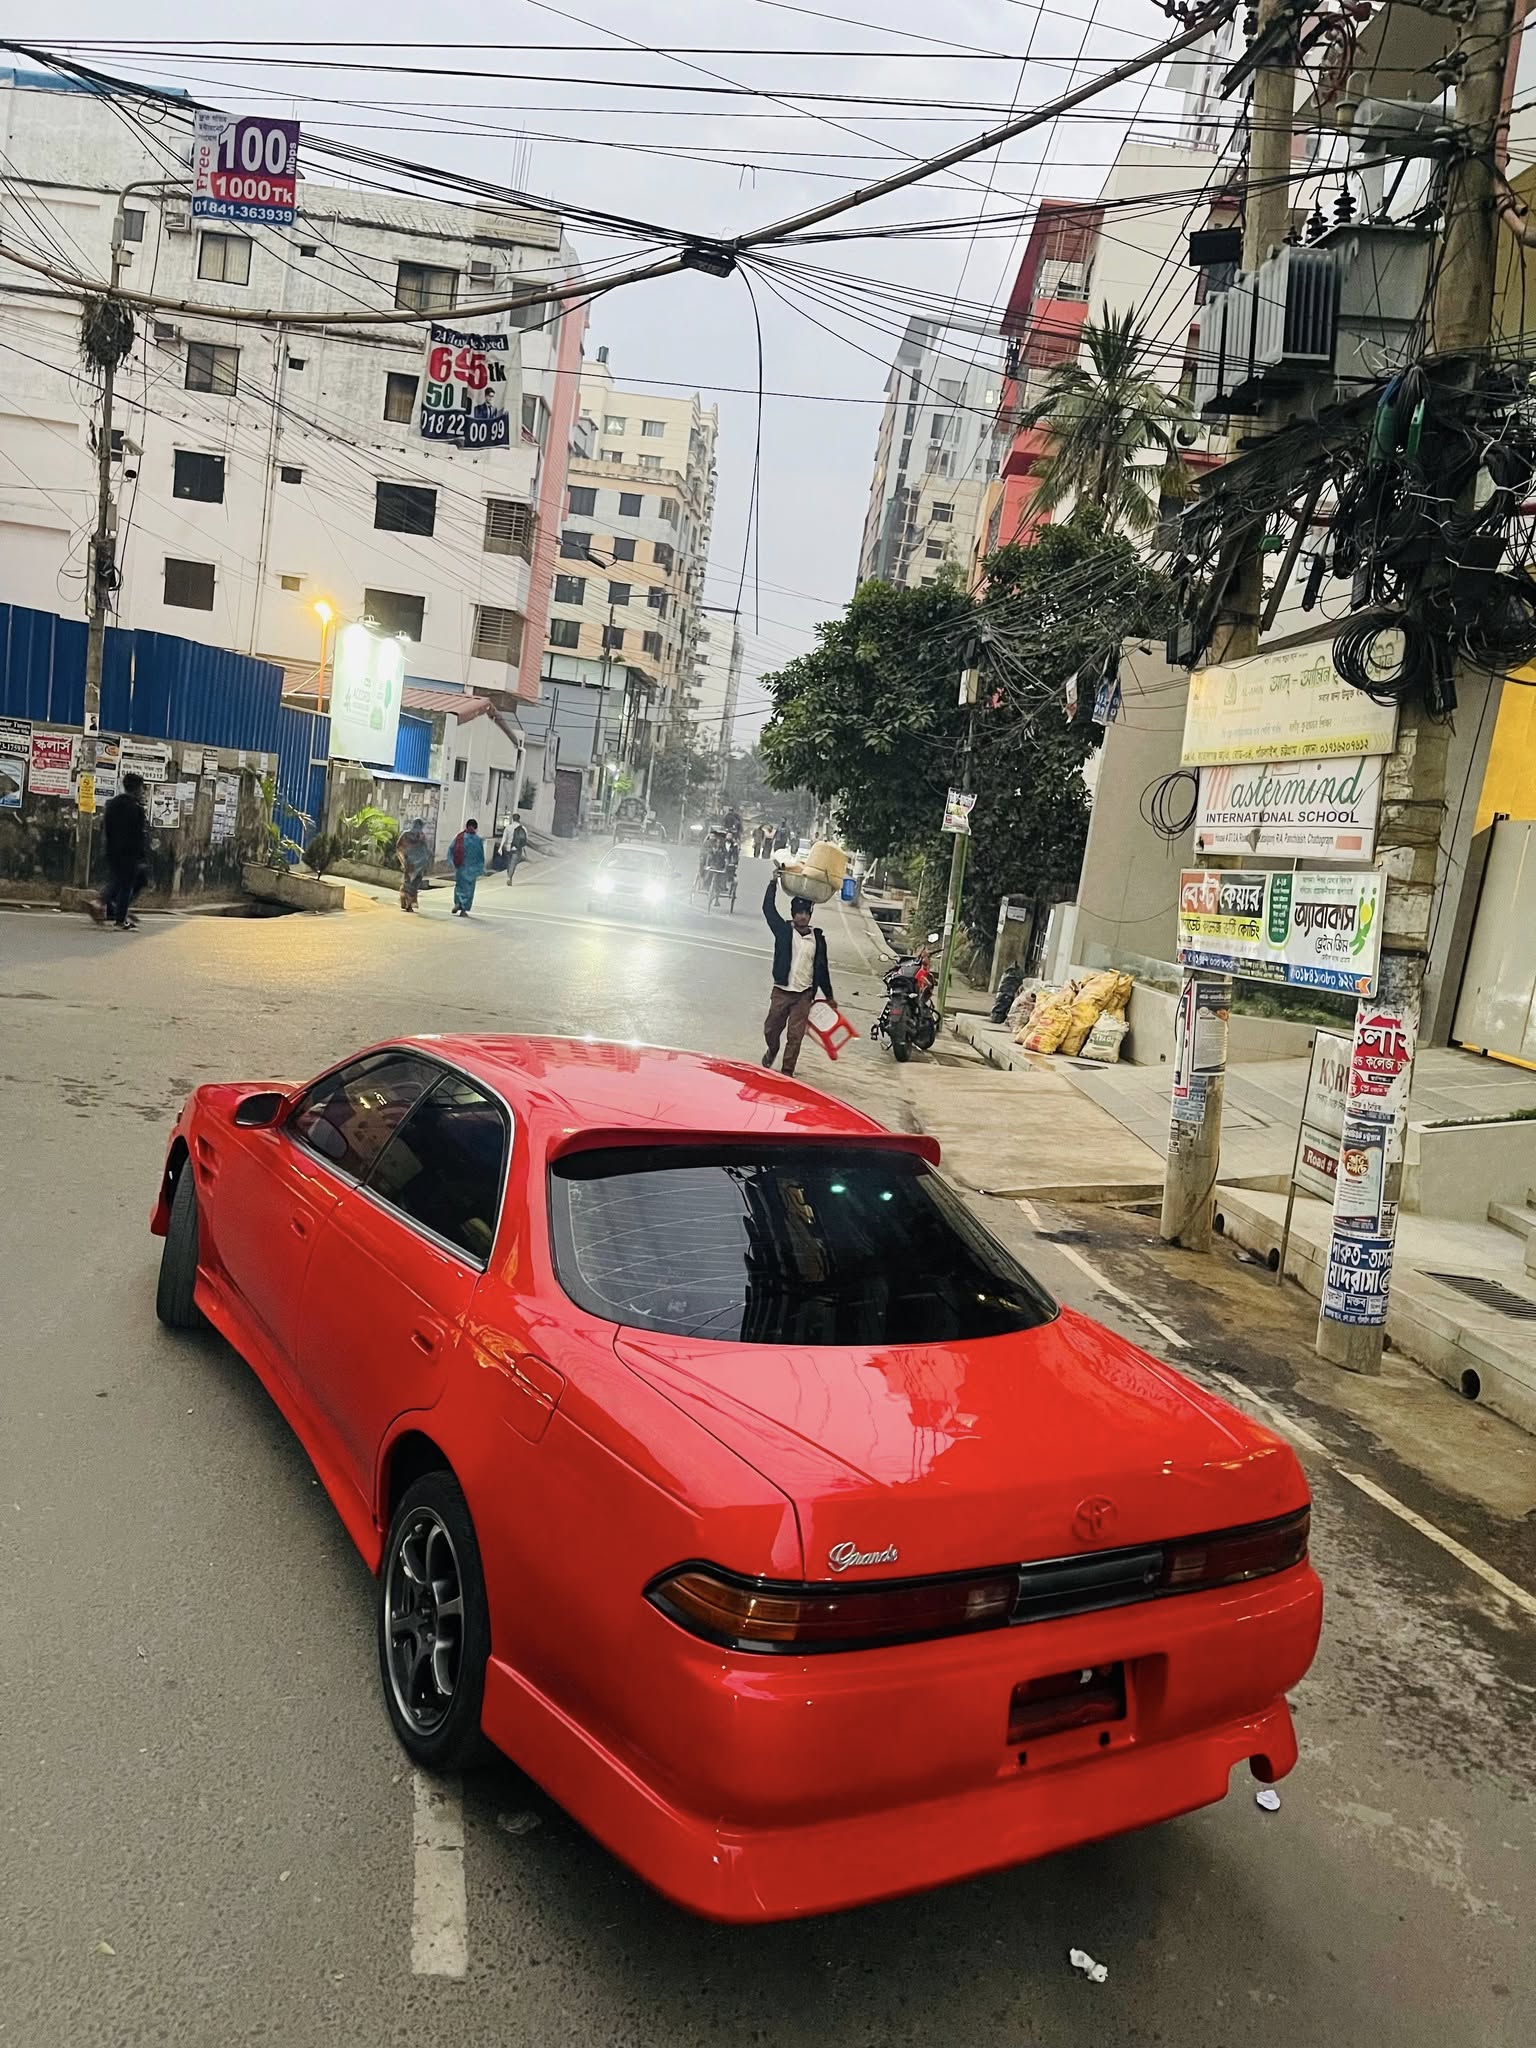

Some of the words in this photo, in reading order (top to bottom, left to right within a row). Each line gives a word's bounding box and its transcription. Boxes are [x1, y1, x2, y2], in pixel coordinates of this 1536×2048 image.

[219, 124, 287, 175] 100
[285, 142, 297, 175] Mbps
[196, 146, 211, 191] Free
[194, 200, 293, 222] 01841-363939
[426, 382, 454, 409] 50
[1206, 756, 1363, 812] Mastermind
[1206, 811, 1294, 823] INTERNATIONAL
[1297, 811, 1359, 823] SCHOOL
[1220, 884, 1262, 912] কেয়ার
[1238, 919, 1260, 940] কোচিং
[1294, 902, 1357, 938] অ্যাবাকাস
[1365, 1057, 1395, 1072] কলেজ
[1306, 1150, 1326, 1170] Road
[1329, 1261, 1380, 1294] মাদরাসা
[828, 1541, 898, 1573] Grande
